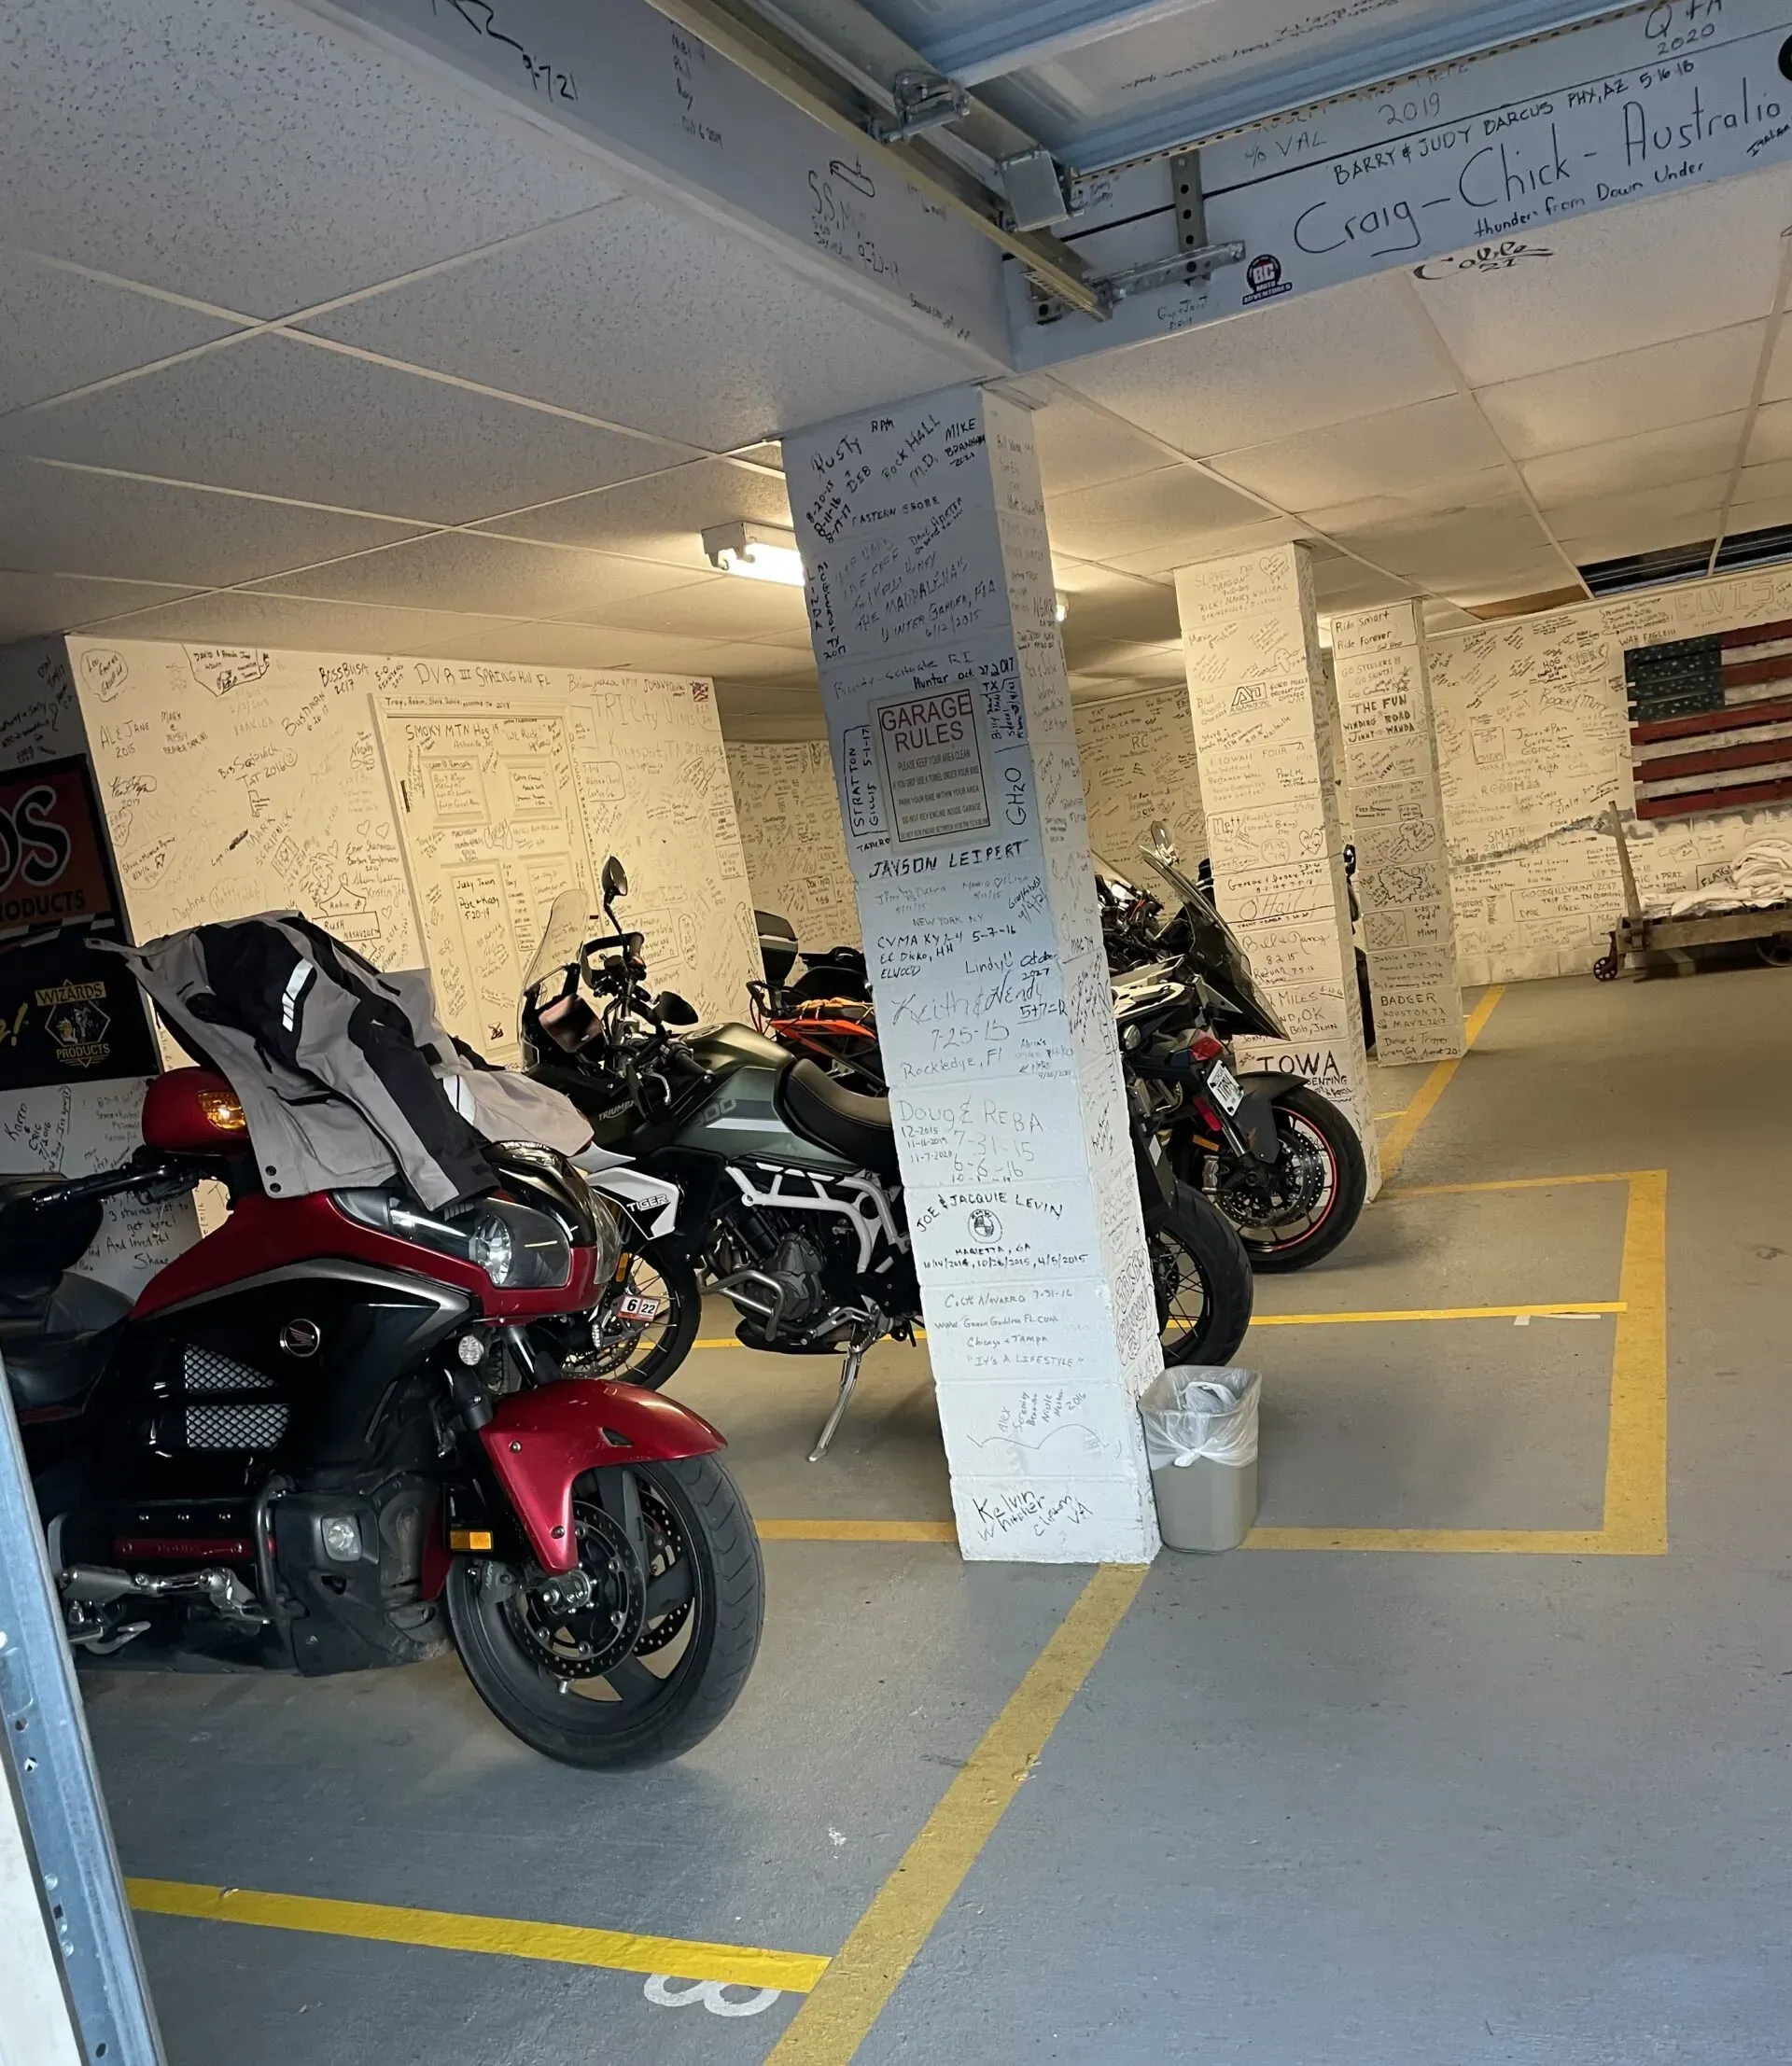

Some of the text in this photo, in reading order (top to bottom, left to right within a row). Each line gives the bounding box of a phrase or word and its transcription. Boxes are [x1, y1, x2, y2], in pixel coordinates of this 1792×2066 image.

[1378, 91, 1441, 126] 2019
[1334, 149, 1396, 186] BARRY
[1418, 124, 1472, 157] JUDY
[1294, 201, 1421, 258] Craig
[1458, 122, 1571, 207] Chick
[1545, 195, 1587, 216] from
[1597, 180, 1644, 202] Down
[1654, 161, 1705, 185] Under
[945, 417, 977, 443] MIKE
[1673, 579, 1775, 622] ELVIS
[1358, 609, 1391, 628] Smart
[1337, 630, 1394, 651] Ride Forever
[912, 672, 950, 691] Hunter
[881, 693, 973, 732] GARAGE
[1351, 693, 1408, 715] THE FUN
[122, 719, 152, 738] JANE
[1343, 710, 1412, 733] WINDING ROAD
[1385, 721, 1416, 737] WANDA
[405, 723, 442, 742] SMOKY
[444, 723, 470, 738] MTN
[895, 720, 964, 754] RULES
[897, 748, 972, 772] PLEASE KEEP YOUR AREA CLEAN
[846, 746, 865, 828] STRATTON
[898, 797, 912, 807] PARK
[911, 794, 924, 804] YOUR
[952, 787, 967, 798] YOUR
[966, 784, 980, 795] AREA
[961, 802, 982, 814] GARAGE
[912, 916, 935, 928] NEW
[937, 914, 962, 928] YORK
[37, 983, 104, 1006] WIZARDS
[1278, 990, 1319, 1008] MILES
[1380, 992, 1438, 1008] BADGER
[1301, 1007, 1325, 1022] OK
[1393, 1019, 1416, 1029] MAY
[56, 1043, 111, 1060] PRODUCTS
[1255, 1050, 1341, 1077] IOWA
[626, 1193, 669, 1212] TIGER
[917, 1191, 1064, 1233] JOE JACQUIE LEVIN
[626, 1298, 638, 1312] 6
[640, 1303, 656, 1315] 22
